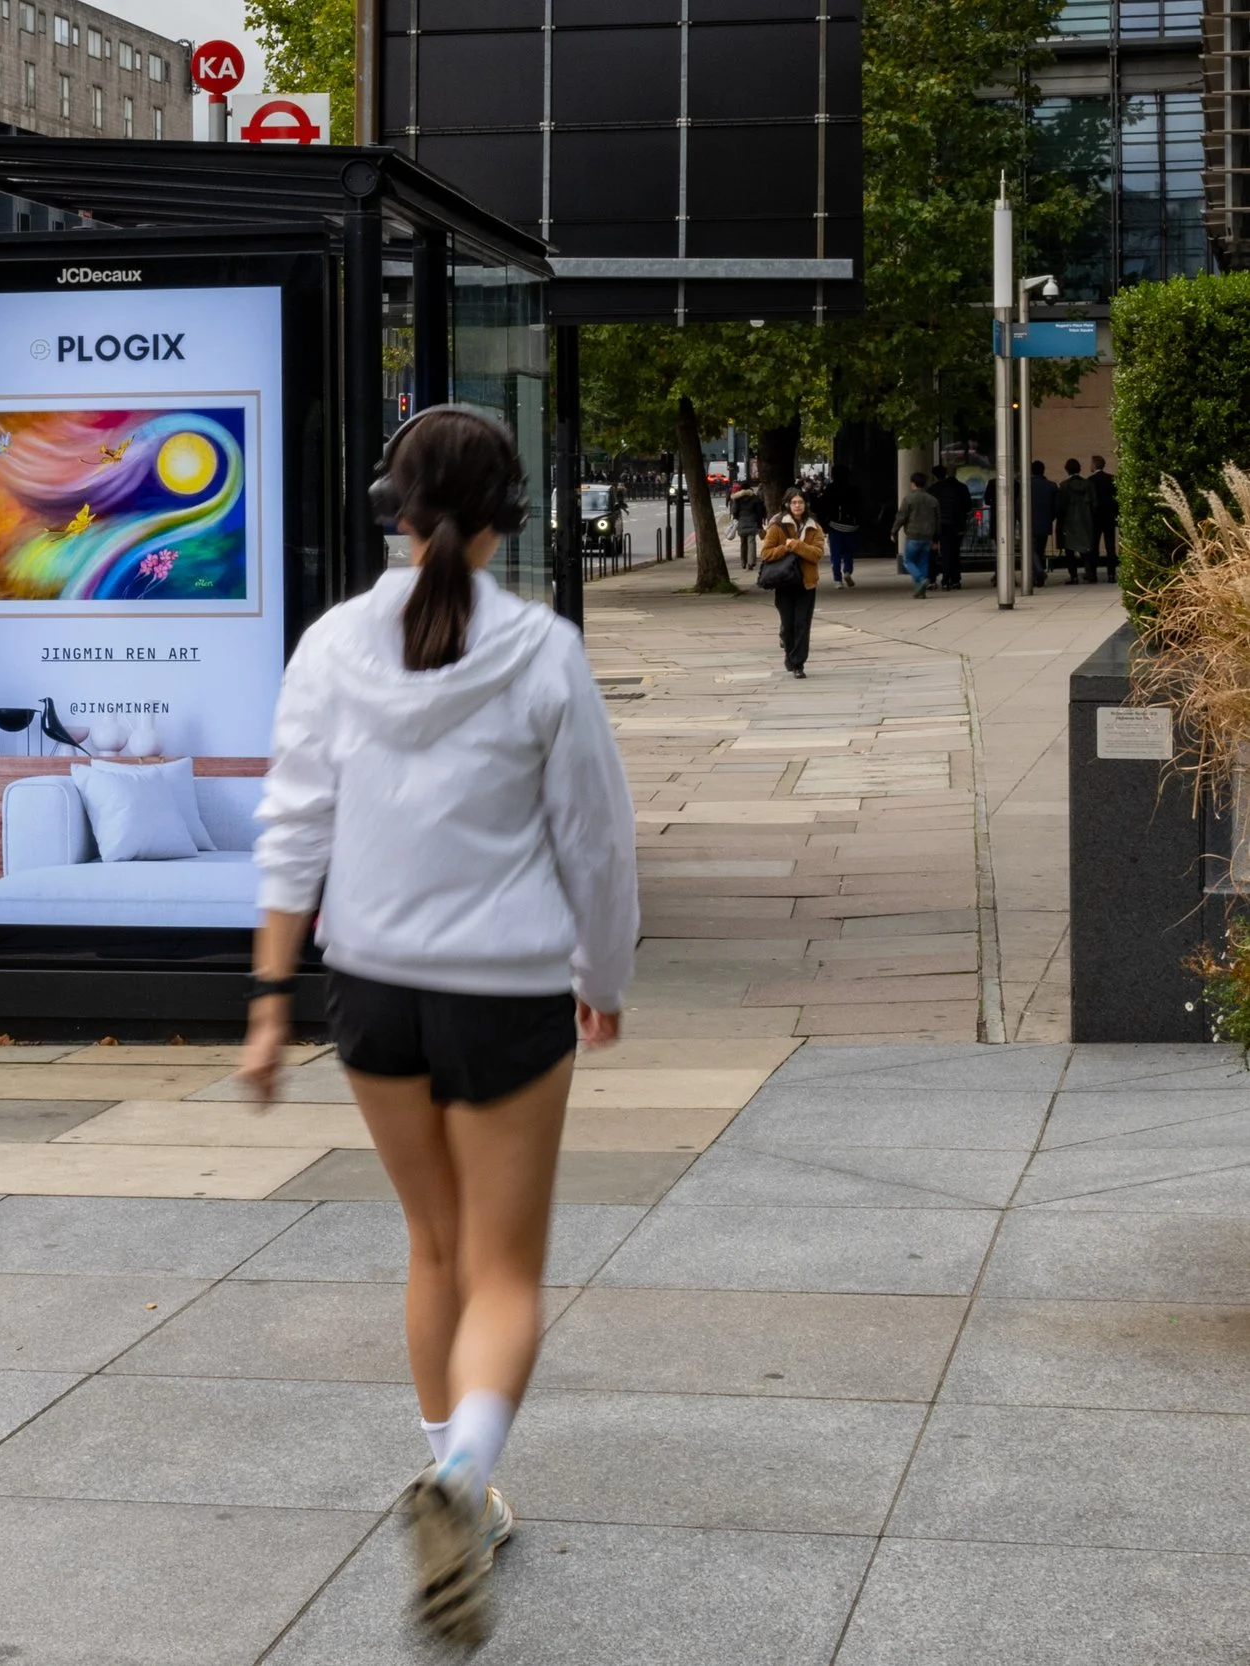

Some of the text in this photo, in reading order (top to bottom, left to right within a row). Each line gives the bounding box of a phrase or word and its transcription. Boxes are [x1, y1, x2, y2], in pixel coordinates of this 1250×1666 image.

[200, 56, 238, 79] KA
[57, 268, 142, 284] JCDecaux
[58, 333, 185, 362] PLOGIX
[41, 648, 199, 660] JINGMIN REN ART
[70, 702, 169, 715] @JINGMINREN
